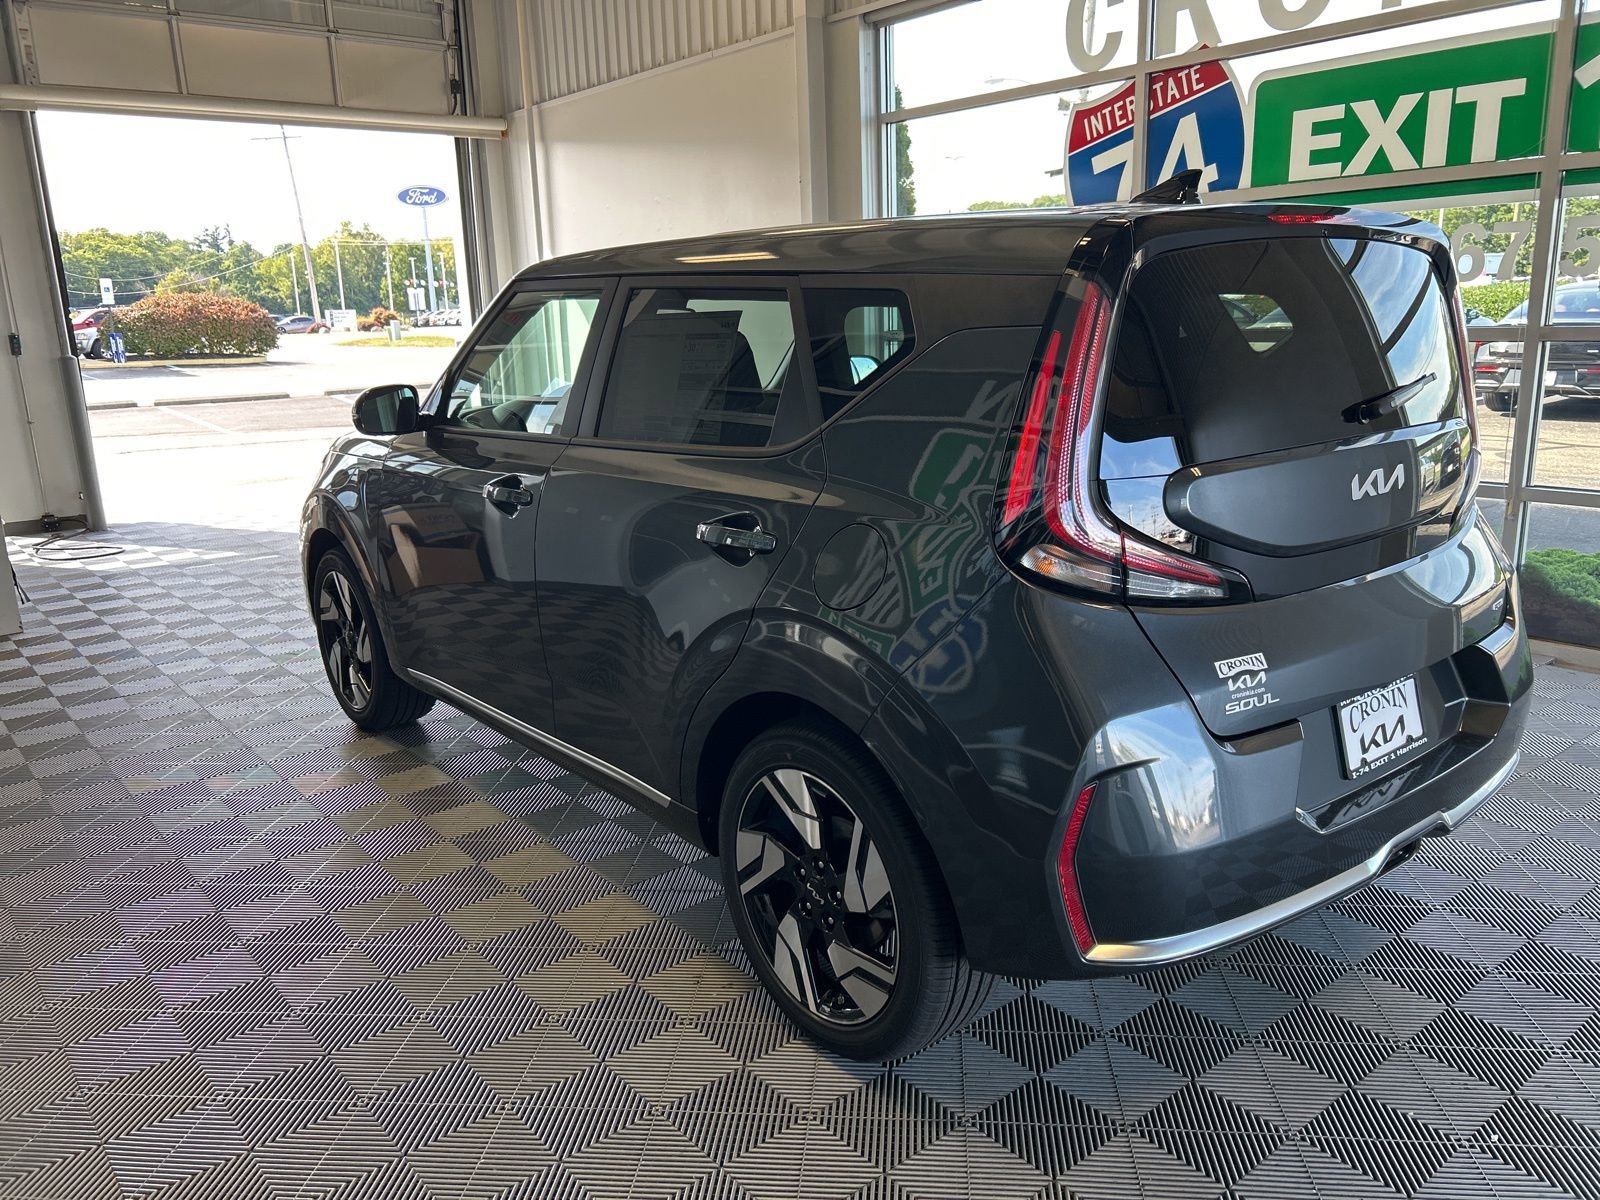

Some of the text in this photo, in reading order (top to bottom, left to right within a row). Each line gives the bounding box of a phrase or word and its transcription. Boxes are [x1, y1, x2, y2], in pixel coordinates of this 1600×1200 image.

[1083, 65, 1205, 142] INTERTATE
[1288, 78, 1527, 183] EXIT
[406, 189, 438, 204] Ford
[1351, 464, 1405, 501] KIA
[1218, 654, 1265, 676] CRONIN
[1228, 671, 1266, 691] KIA
[1225, 693, 1280, 715] SOUL
[1231, 687, 1266, 699] croninkia.com
[1350, 683, 1408, 734] CRONIN
[1360, 714, 1406, 756] KIA
[1352, 765, 1370, 779] I-74
[1370, 755, 1390, 770] EXIT
[1396, 737, 1428, 757] Harrison
